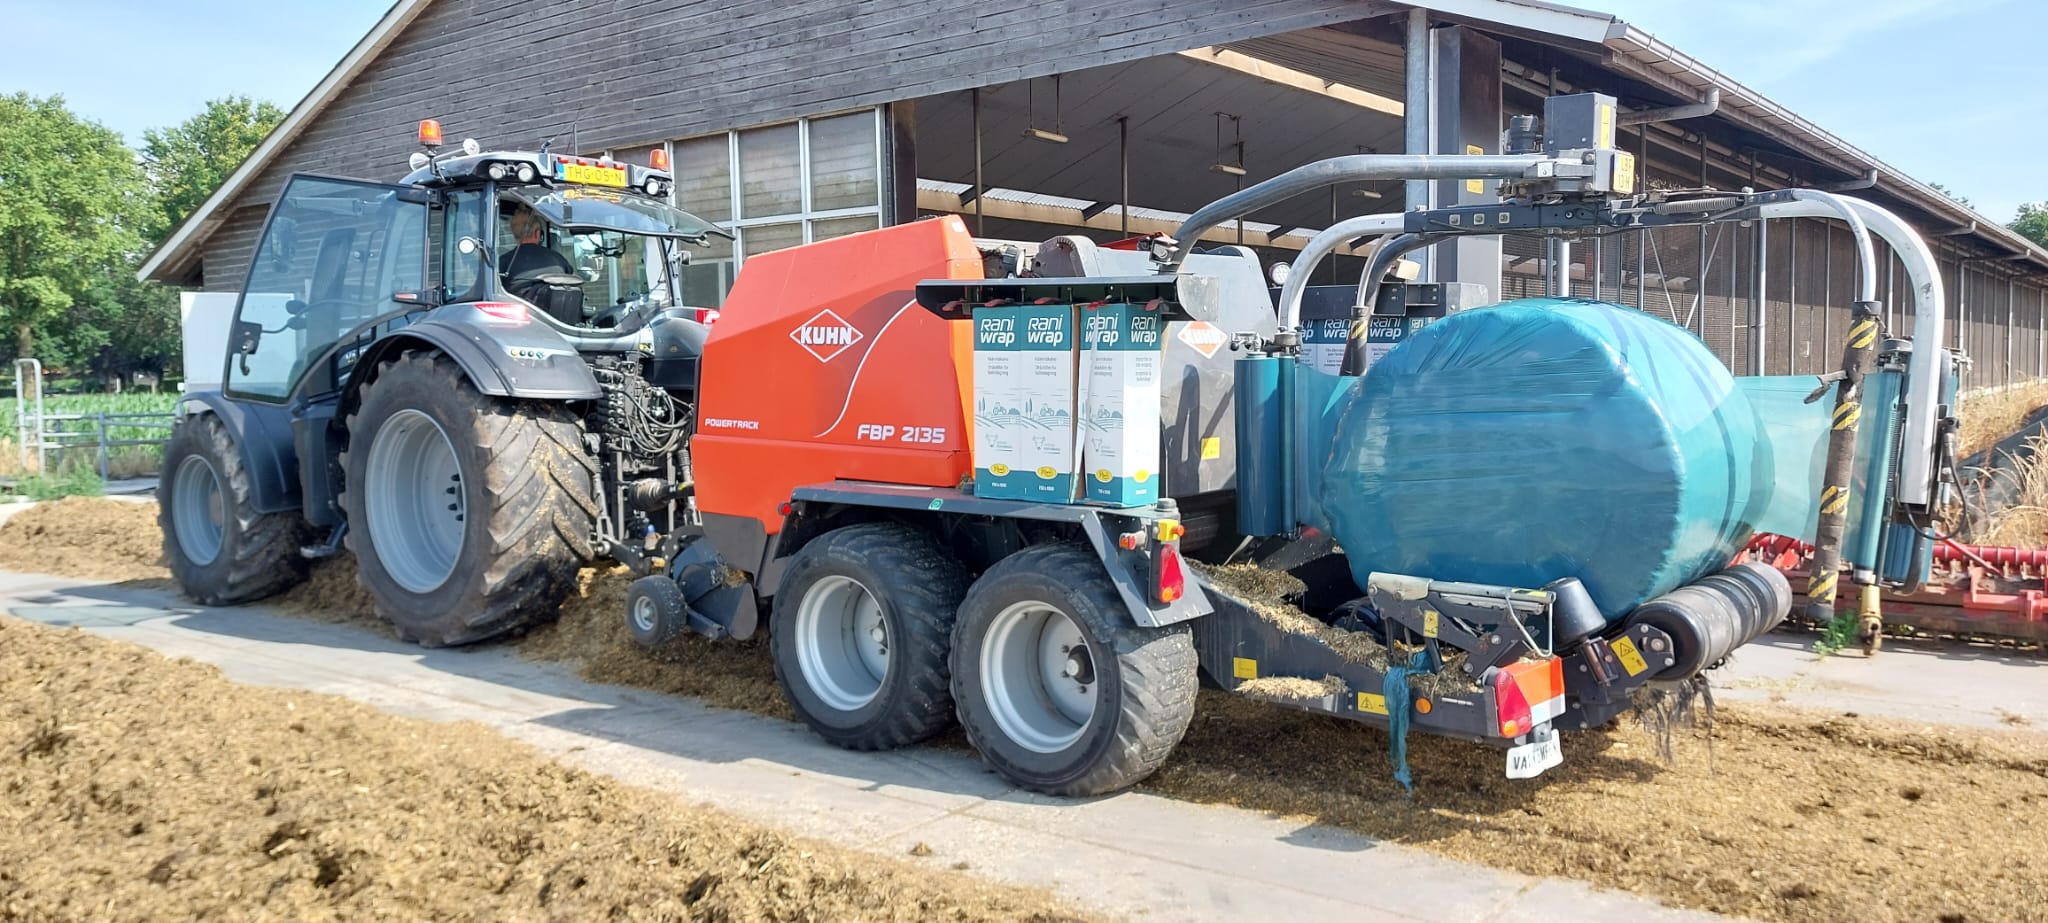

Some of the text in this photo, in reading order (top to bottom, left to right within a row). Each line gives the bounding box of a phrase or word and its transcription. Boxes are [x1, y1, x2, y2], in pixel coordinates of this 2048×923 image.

[567, 166, 622, 184] THG-05-N
[980, 315, 1015, 332] Rani
[1028, 314, 1064, 331] Rani
[1131, 313, 1157, 330] Rani
[1323, 319, 1351, 329] Ran
[800, 326, 852, 345] KUHN
[980, 330, 1015, 347] wrap
[1028, 331, 1064, 347] wrap
[1131, 330, 1157, 347] wrap
[1323, 329, 1349, 339] wra
[1369, 327, 1402, 340] wrap
[704, 418, 759, 430] POWERTRACK
[857, 423, 946, 444] FBP 2135
